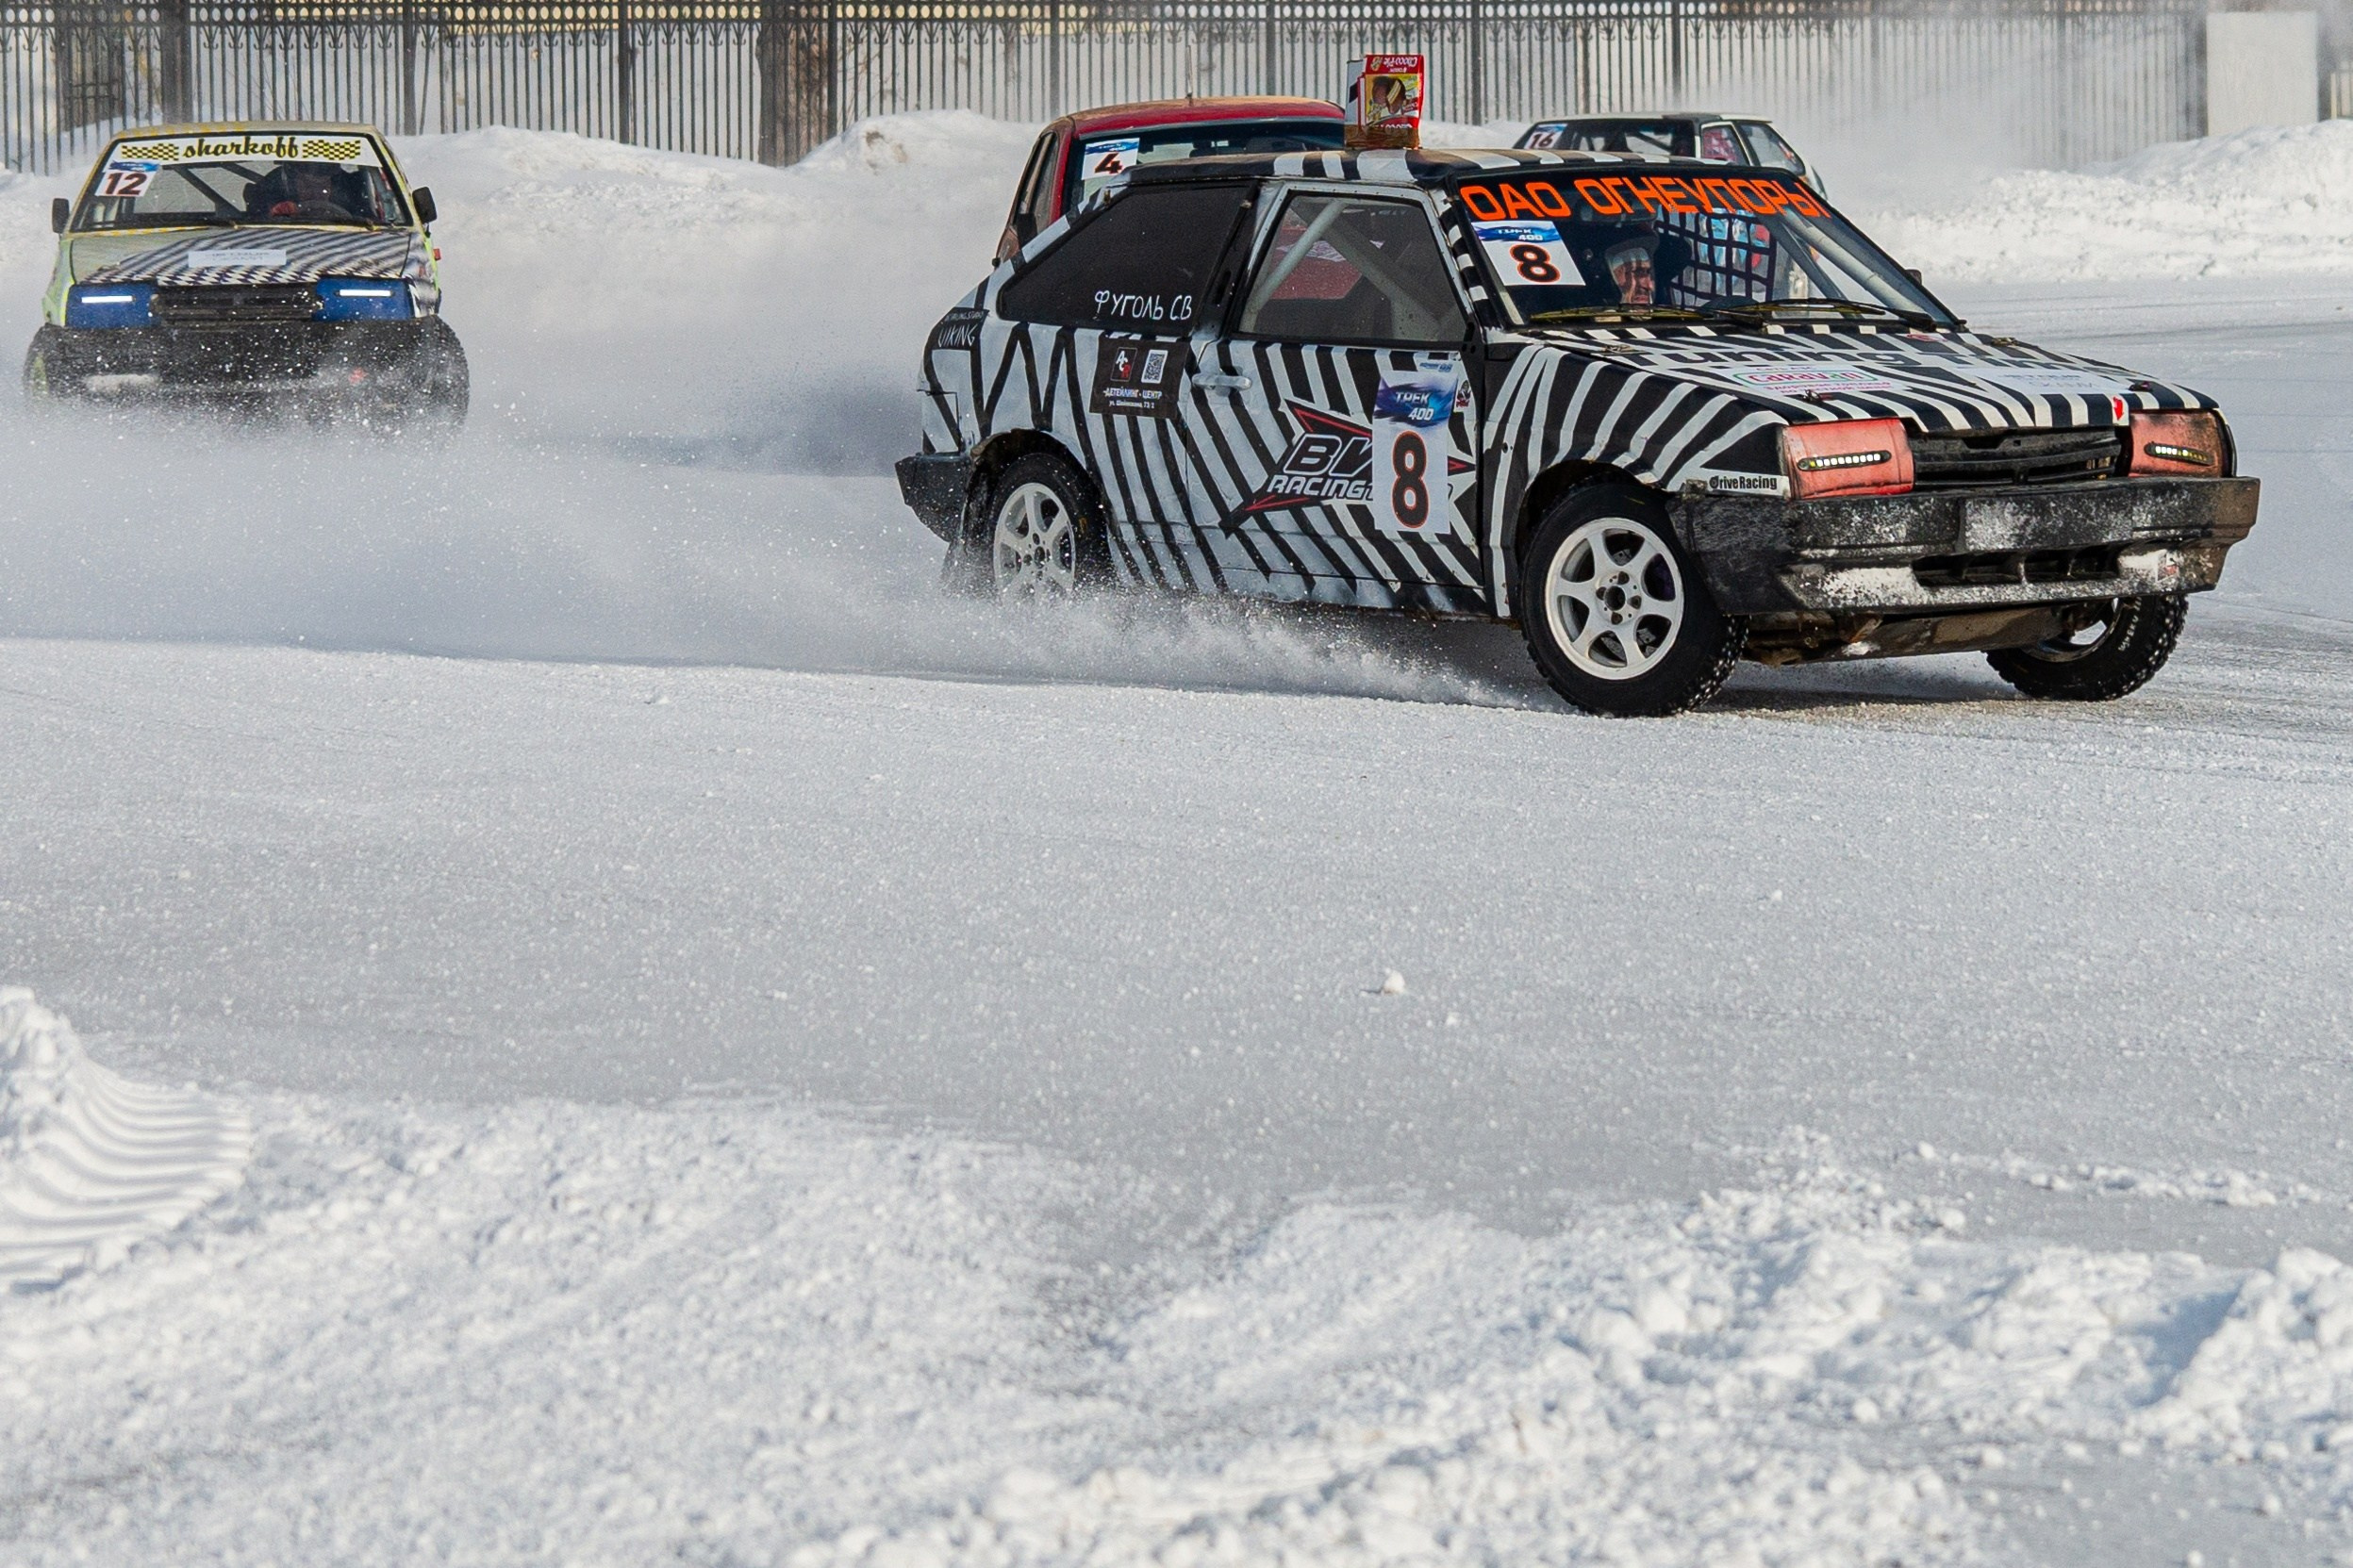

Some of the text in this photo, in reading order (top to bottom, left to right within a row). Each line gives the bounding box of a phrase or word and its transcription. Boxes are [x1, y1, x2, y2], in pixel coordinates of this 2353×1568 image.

[183, 136, 299, 158] sharkoff
[1529, 133, 1555, 149] 16
[1094, 150, 1123, 174] 4
[103, 172, 148, 196] 12
[1460, 176, 1831, 221] ОАО ОГНЕУПОРЫ
[1510, 242, 1561, 283] 8
[1094, 289, 1192, 321] ФУГОЛЬ СВ
[1408, 408, 1434, 421] 400
[1392, 430, 1430, 529] 8
